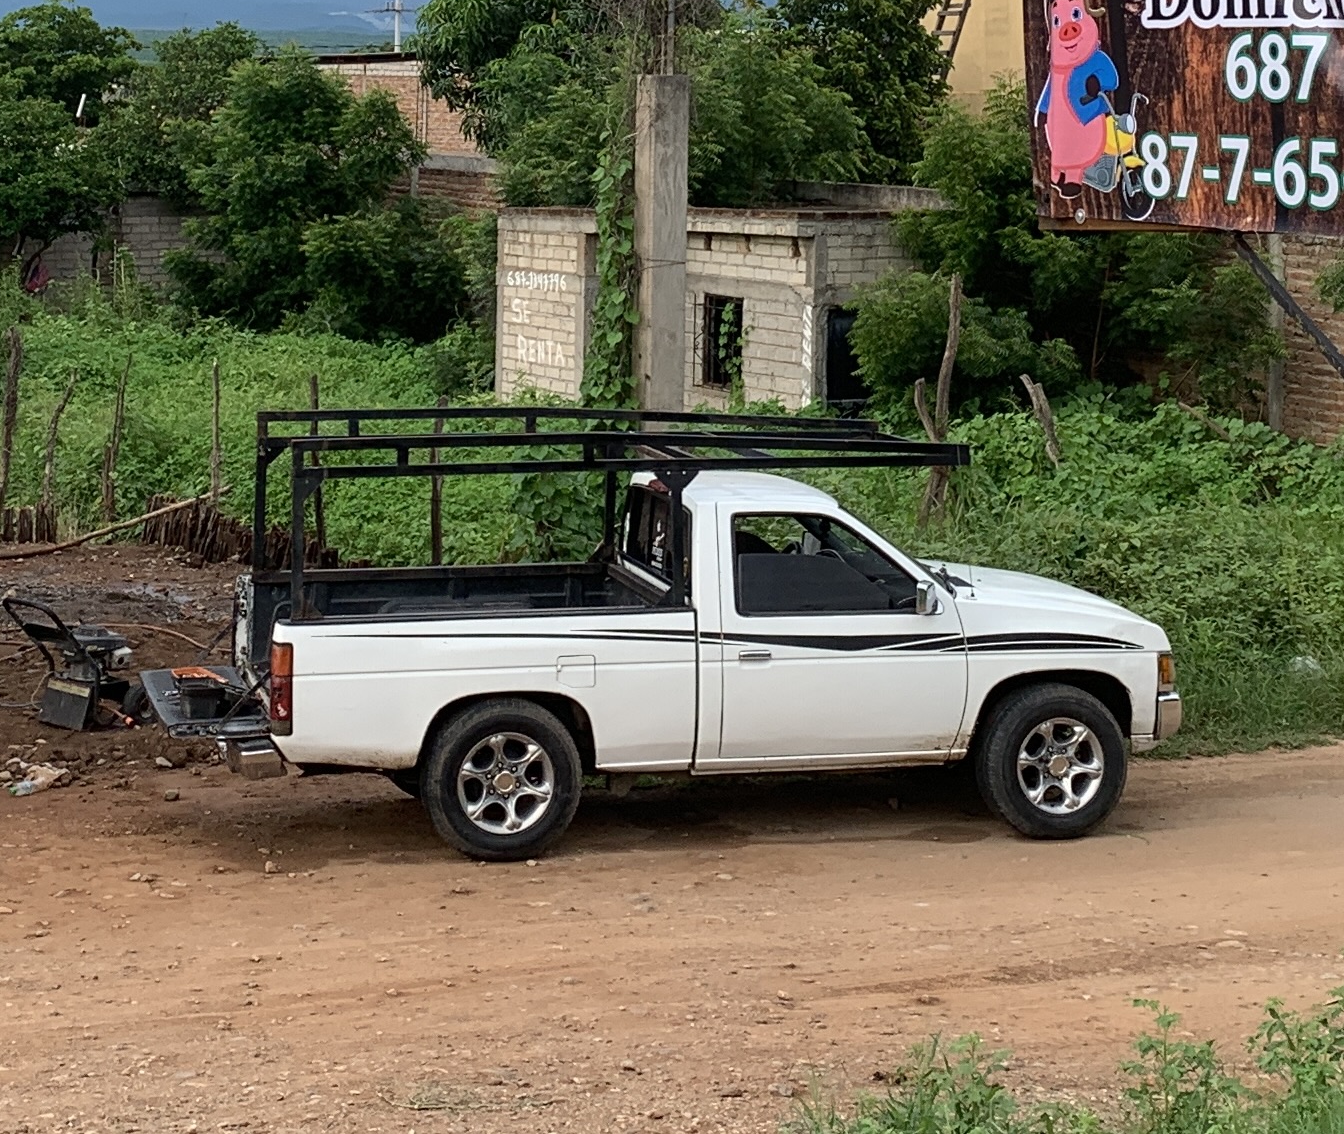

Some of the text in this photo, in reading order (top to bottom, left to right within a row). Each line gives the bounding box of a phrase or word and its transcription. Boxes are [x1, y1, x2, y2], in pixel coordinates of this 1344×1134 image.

[1225, 32, 1327, 102] 687
[511, 298, 531, 324] SE
[517, 333, 565, 366] RENTA
